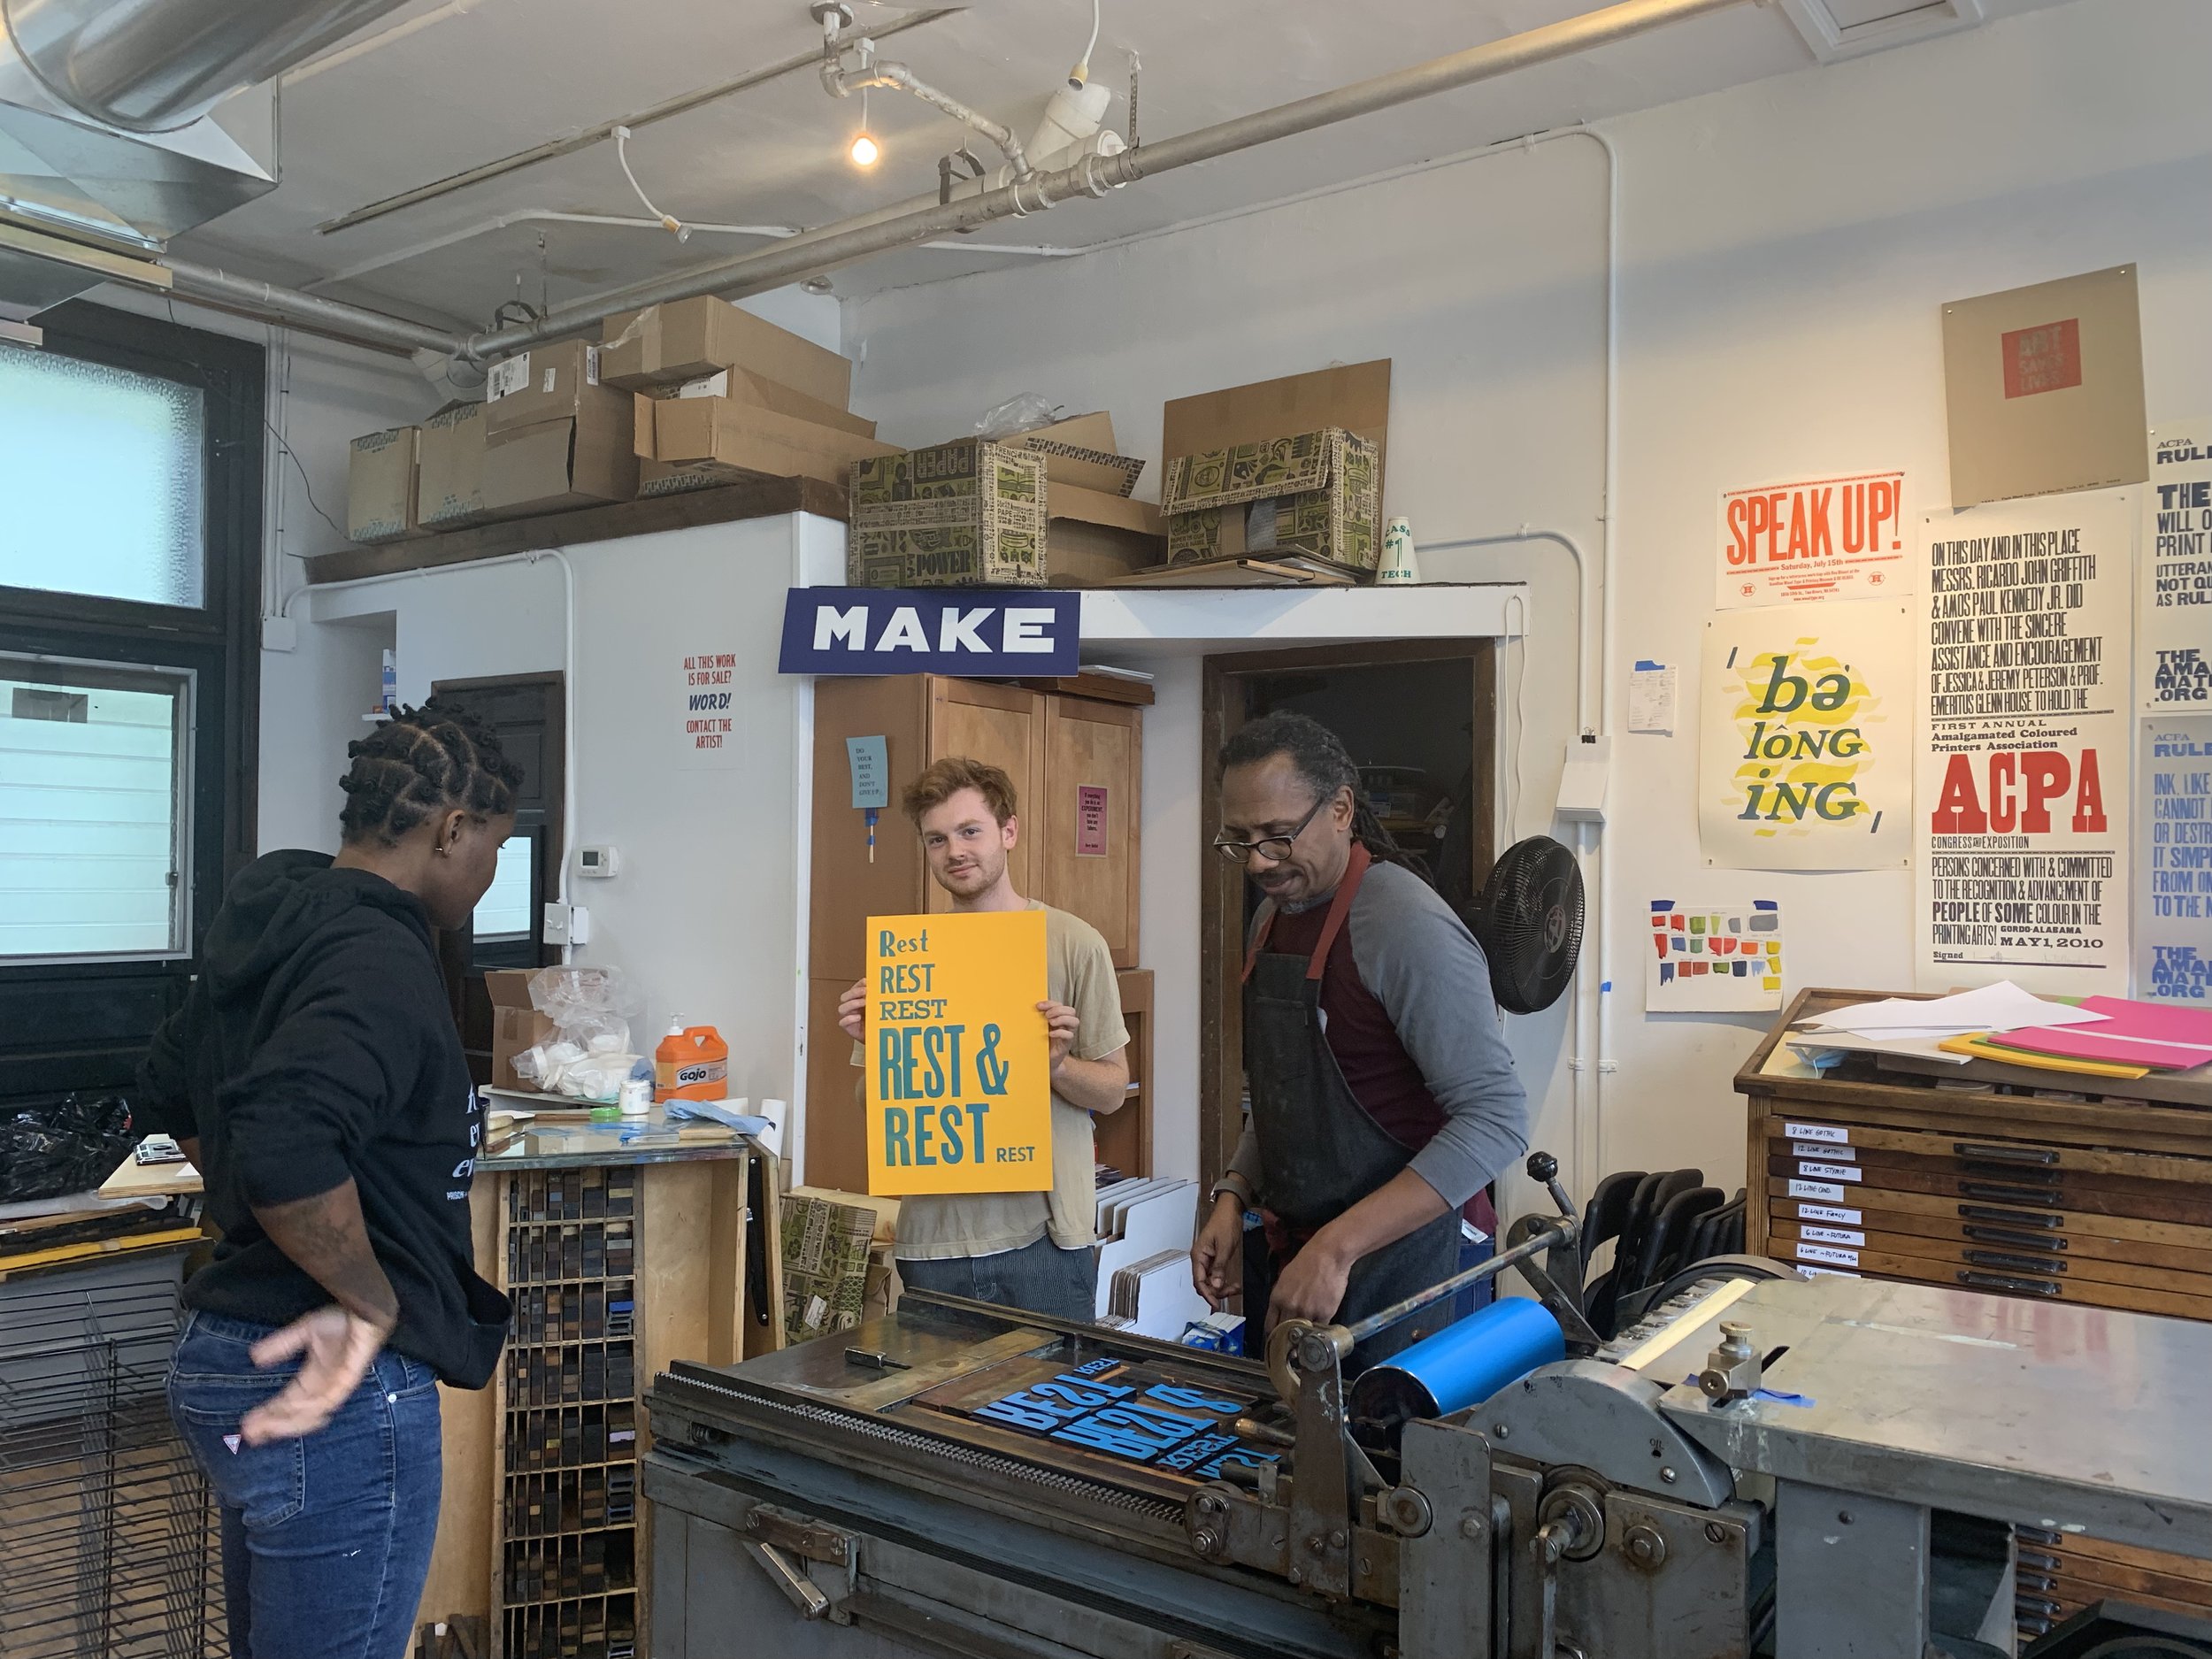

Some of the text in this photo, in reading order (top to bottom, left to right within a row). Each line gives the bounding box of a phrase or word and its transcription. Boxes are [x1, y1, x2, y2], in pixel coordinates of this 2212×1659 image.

[2157, 438, 2193, 449] ACPA
[2157, 481, 2211, 510] THE
[1726, 480, 1901, 565] SPEAK UP!
[2157, 511, 2193, 534] WILL
[1932, 528, 2081, 566] ON THIS DAY AND IN THIS PLACE
[2156, 533, 2205, 557] PRINT
[916, 549, 971, 577] POWER
[1780, 562, 1812, 572] Saturday,
[1814, 560, 1826, 569] July
[1932, 554, 2096, 593] MESSRS. RICARDO JOHN GRIFFITH
[1381, 570, 1411, 579] TECH
[2156, 577, 2191, 592] NOT
[2156, 594, 2172, 607] AS
[813, 605, 1056, 653] MAKE
[684, 653, 736, 670] ALL THIS WORK
[1932, 636, 2102, 672] ASSISTANCE AND ENCOURAGEMENT
[2155, 649, 2200, 664] THE
[688, 670, 732, 686] IS FOR SALE?
[1932, 664, 2103, 694] OF JESSICA & JEREMY PETERSON & PROF.
[2156, 662, 2212, 676] AMA
[2154, 674, 2212, 689] MAT
[689, 693, 732, 710] WORD!
[1932, 687, 2088, 716] EMERITUS GLENN HOUSE TO HOLD THE
[2154, 687, 2208, 703] .ORG
[687, 718, 732, 733] CONTACT THE
[1932, 719, 2047, 731] FIRST ANNUAL
[1932, 727, 2078, 742] Amalgamated Coloured
[695, 735, 723, 749] ARTIST!
[1932, 740, 2058, 752] Printers Association
[1932, 749, 2108, 834] ACPA
[2184, 772, 2210, 795] LIKE
[2154, 797, 2206, 819] CANNOT
[1932, 836, 1973, 849] CONGRESS
[1982, 836, 2030, 849] EXPOSITION
[2154, 822, 2170, 843] OR
[1932, 857, 2113, 879] PERSONS CONCERNED WITH & COMMITTED
[2154, 847, 2212, 868] IT SIMP
[2153, 871, 2193, 893] FROM
[1932, 902, 2101, 926] PEOPLE OF SOME COLOUR IN THE
[2153, 895, 2201, 918] TO THE
[1932, 924, 1997, 946] PRINTING ARTS!
[2001, 926, 2082, 934] GORDO-ALABAMA
[879, 929, 929, 957] Rest
[2056, 938, 2104, 949] 2010
[1933, 951, 1963, 960] Signed
[880, 964, 935, 994] REST
[879, 999, 948, 1020] REST
[879, 1023, 1009, 1100] REST &
[885, 1103, 1035, 1166] REST REST
[1792, 1126, 1797, 1135] 8
[1824, 1167, 1847, 1176] STYMIE
[1649, 1438, 1665, 1450] OIL
